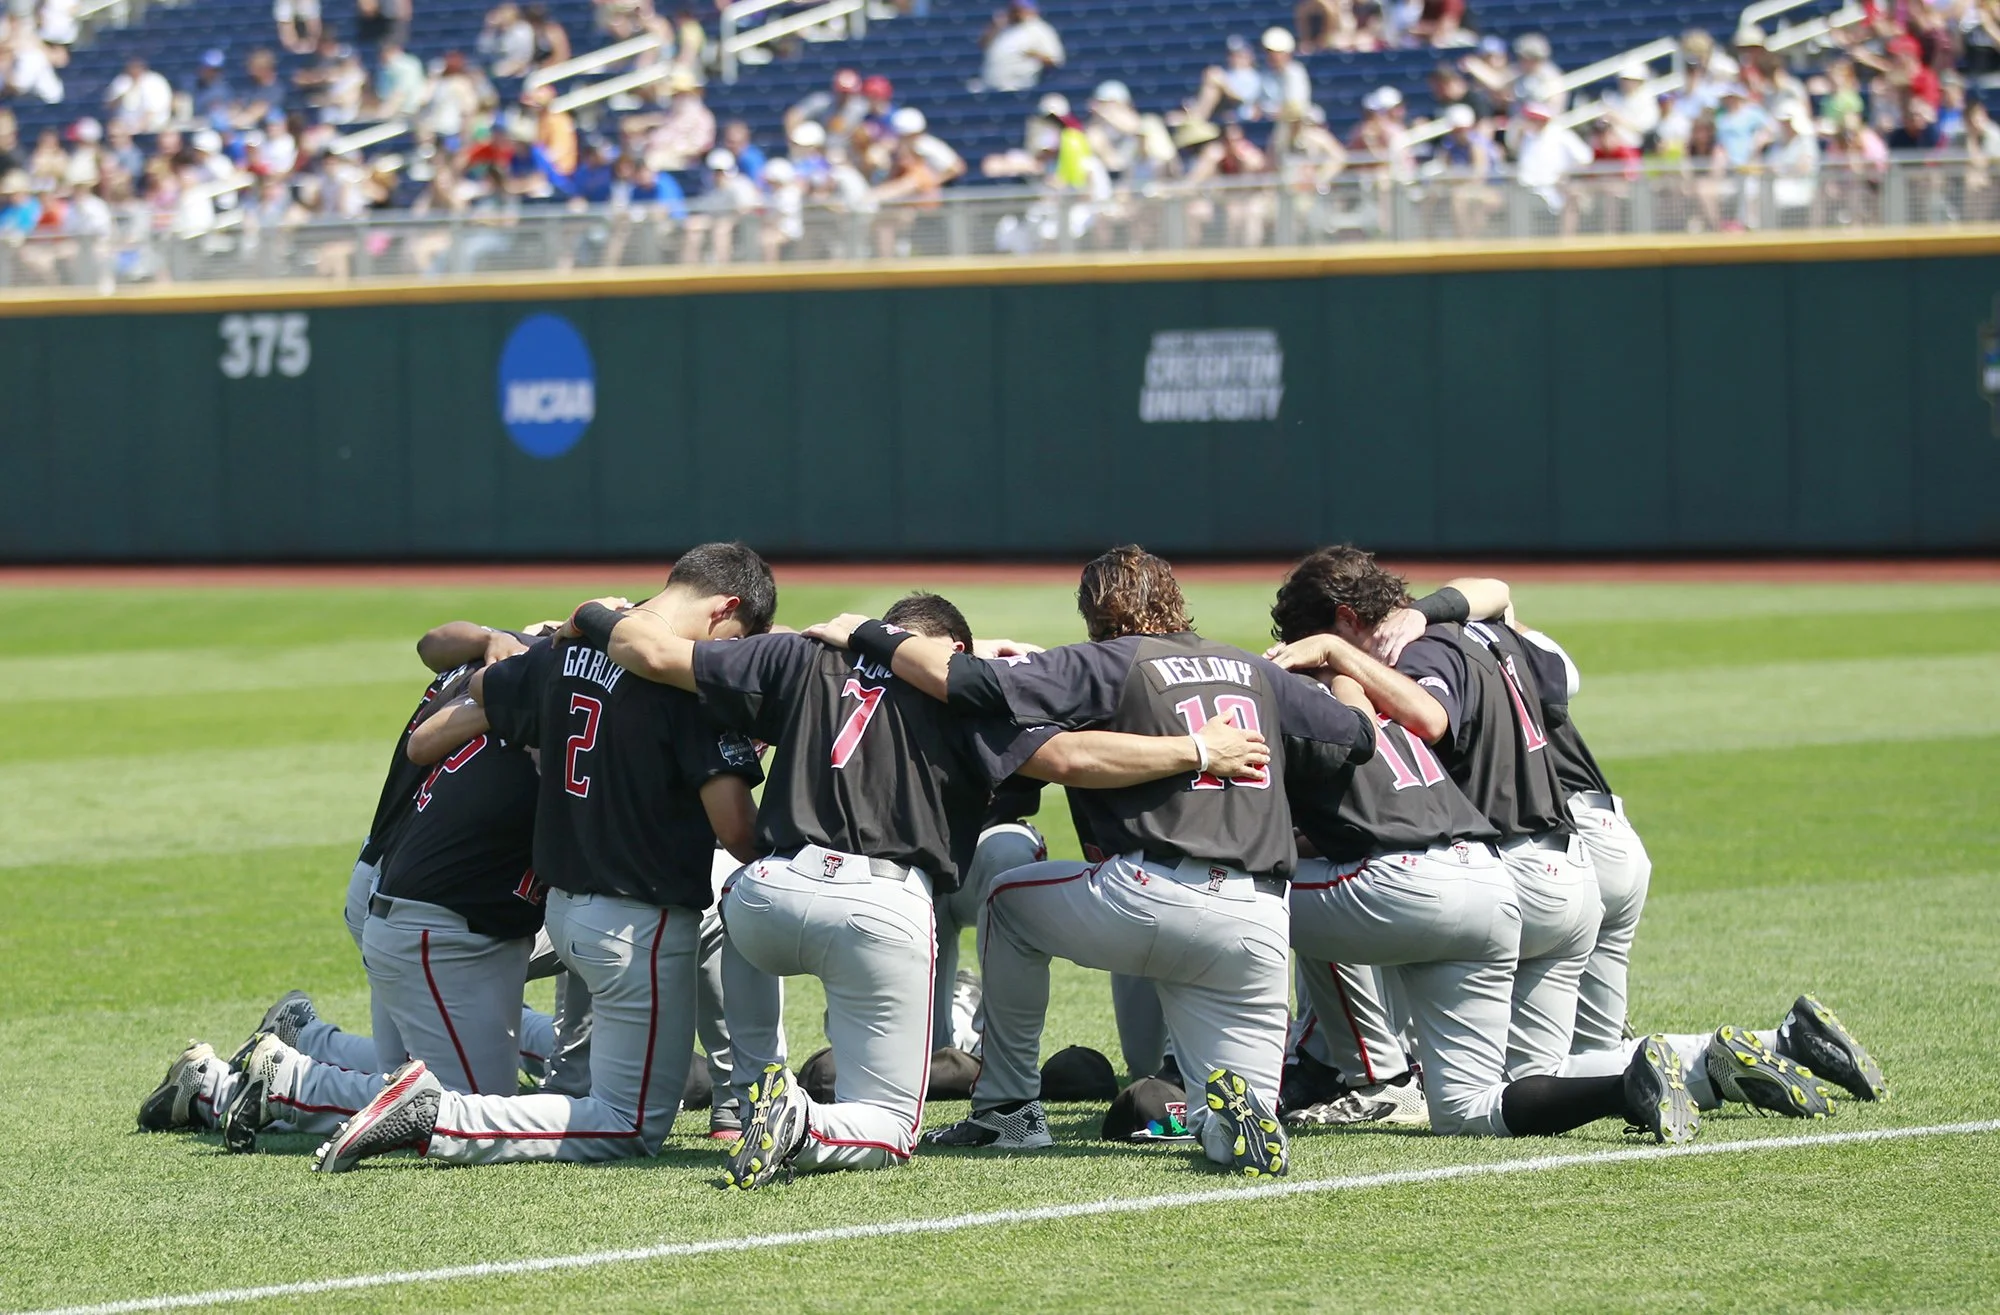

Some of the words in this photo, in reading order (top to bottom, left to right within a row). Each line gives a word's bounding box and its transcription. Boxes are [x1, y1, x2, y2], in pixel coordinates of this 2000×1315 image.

[219, 313, 311, 378] 375
[1145, 353, 1283, 388] CREIGHTON
[503, 379, 596, 424] NCAA
[1139, 386, 1285, 422] UNIVERSITY
[563, 646, 626, 694] GARCIA
[1150, 656, 1252, 687] NESLONY
[565, 692, 603, 798] 2
[830, 678, 887, 769] 7
